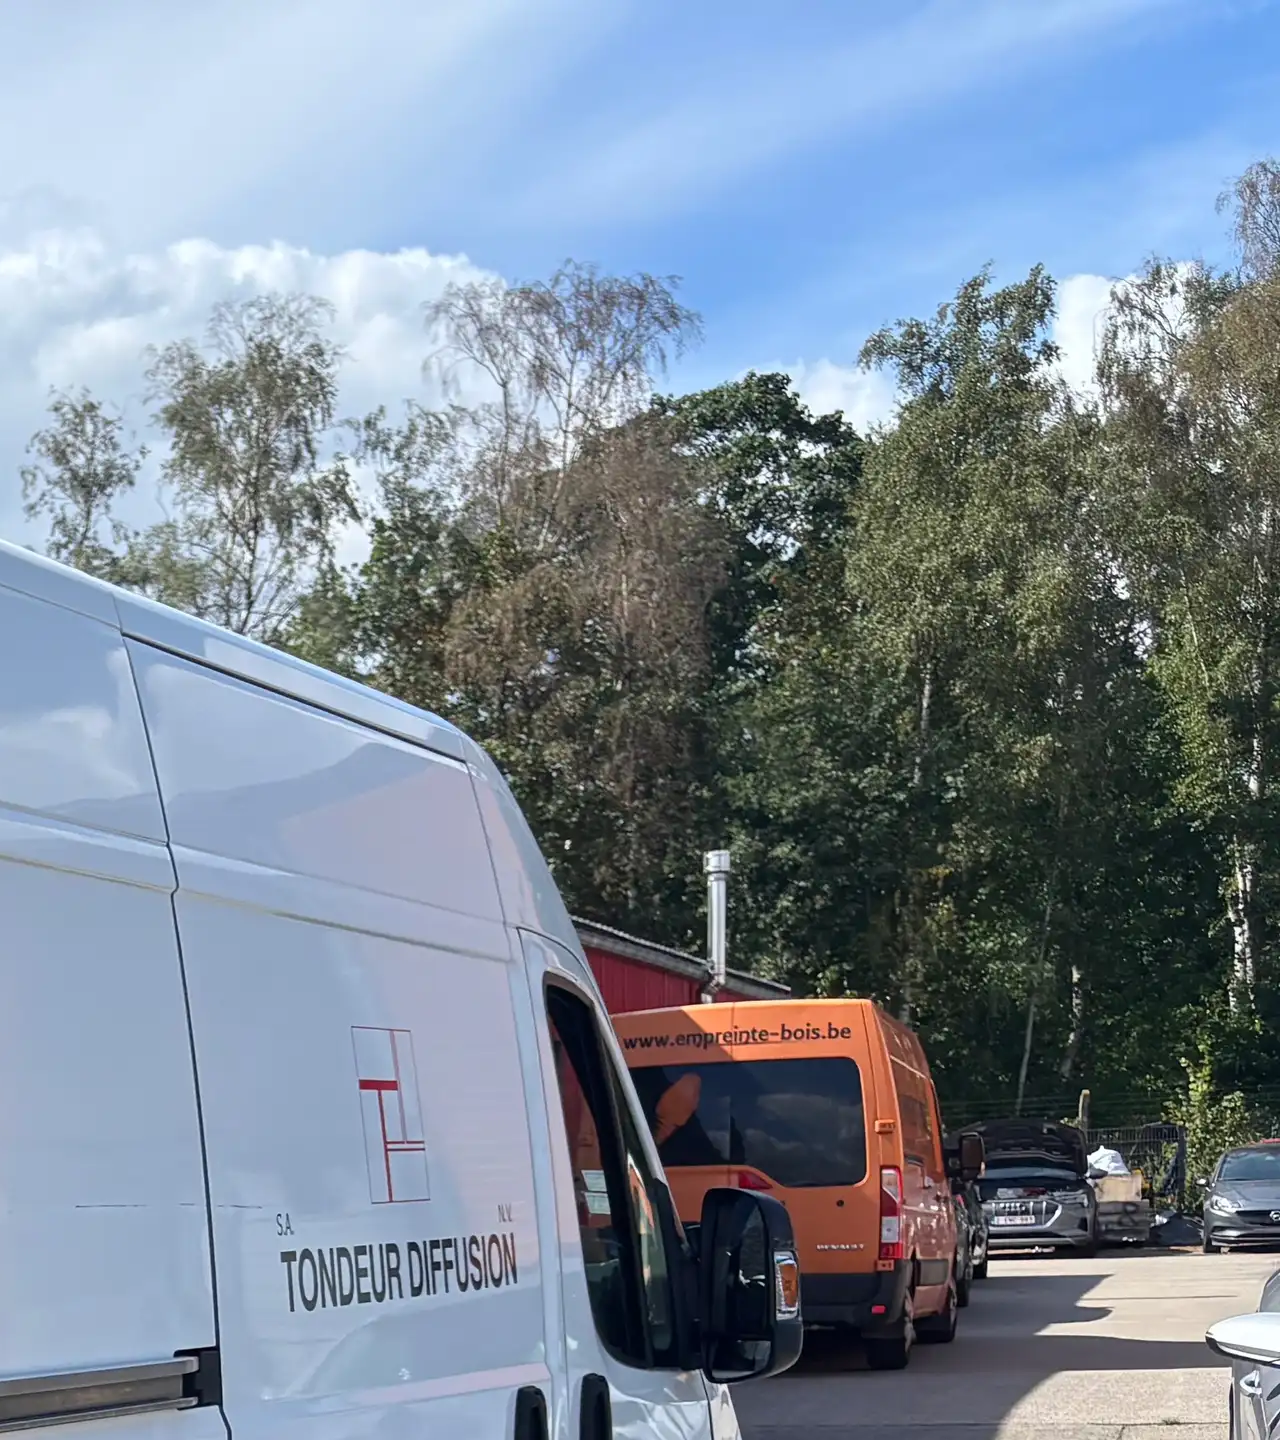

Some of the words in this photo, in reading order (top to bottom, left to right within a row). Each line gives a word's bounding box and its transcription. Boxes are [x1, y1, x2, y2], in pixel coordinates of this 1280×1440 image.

[623, 1022, 852, 1050] www.empreinte-bois.be
[280, 1242, 403, 1312] TONDEUR
[406, 1231, 518, 1297] DIFFUSION
